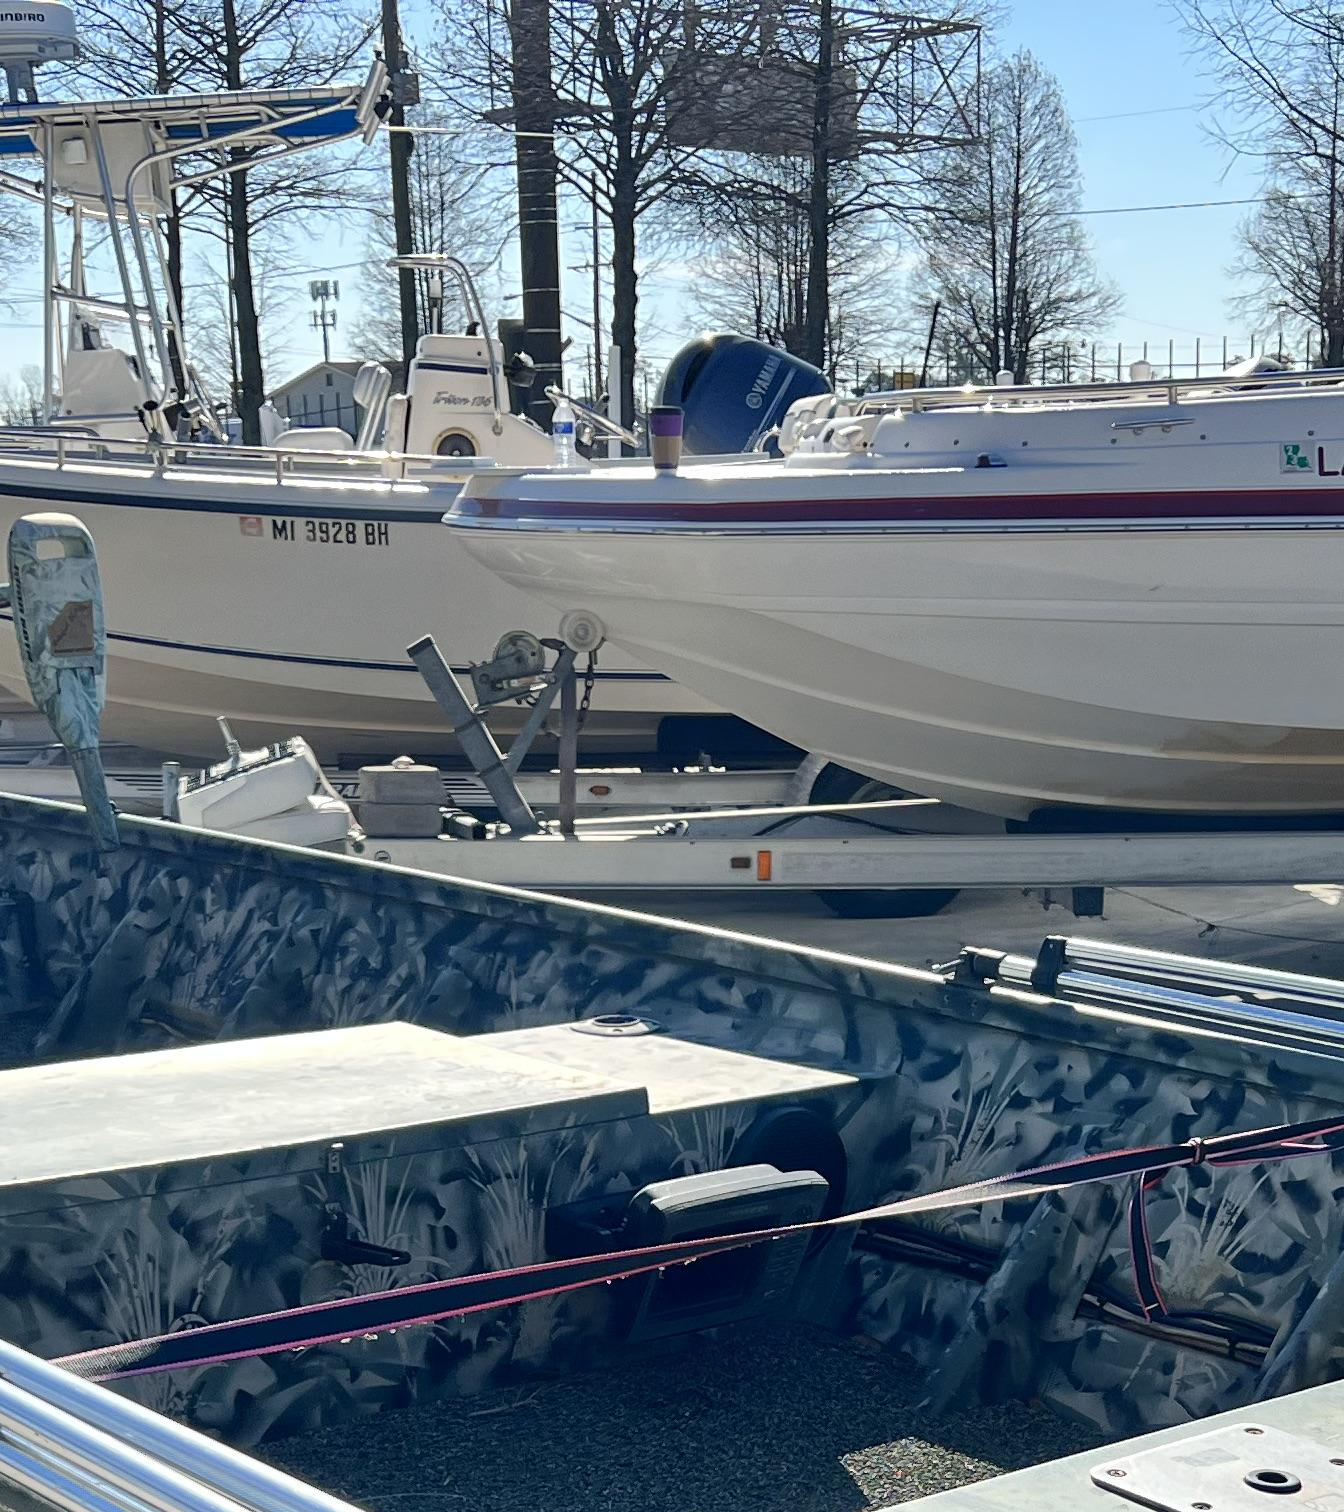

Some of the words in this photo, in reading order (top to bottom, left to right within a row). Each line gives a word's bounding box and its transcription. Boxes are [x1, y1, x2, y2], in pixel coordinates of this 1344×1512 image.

[751, 354, 783, 395] YAMAHA
[272, 519, 296, 541] MI
[305, 520, 357, 545] 3928
[364, 522, 390, 546] BH
